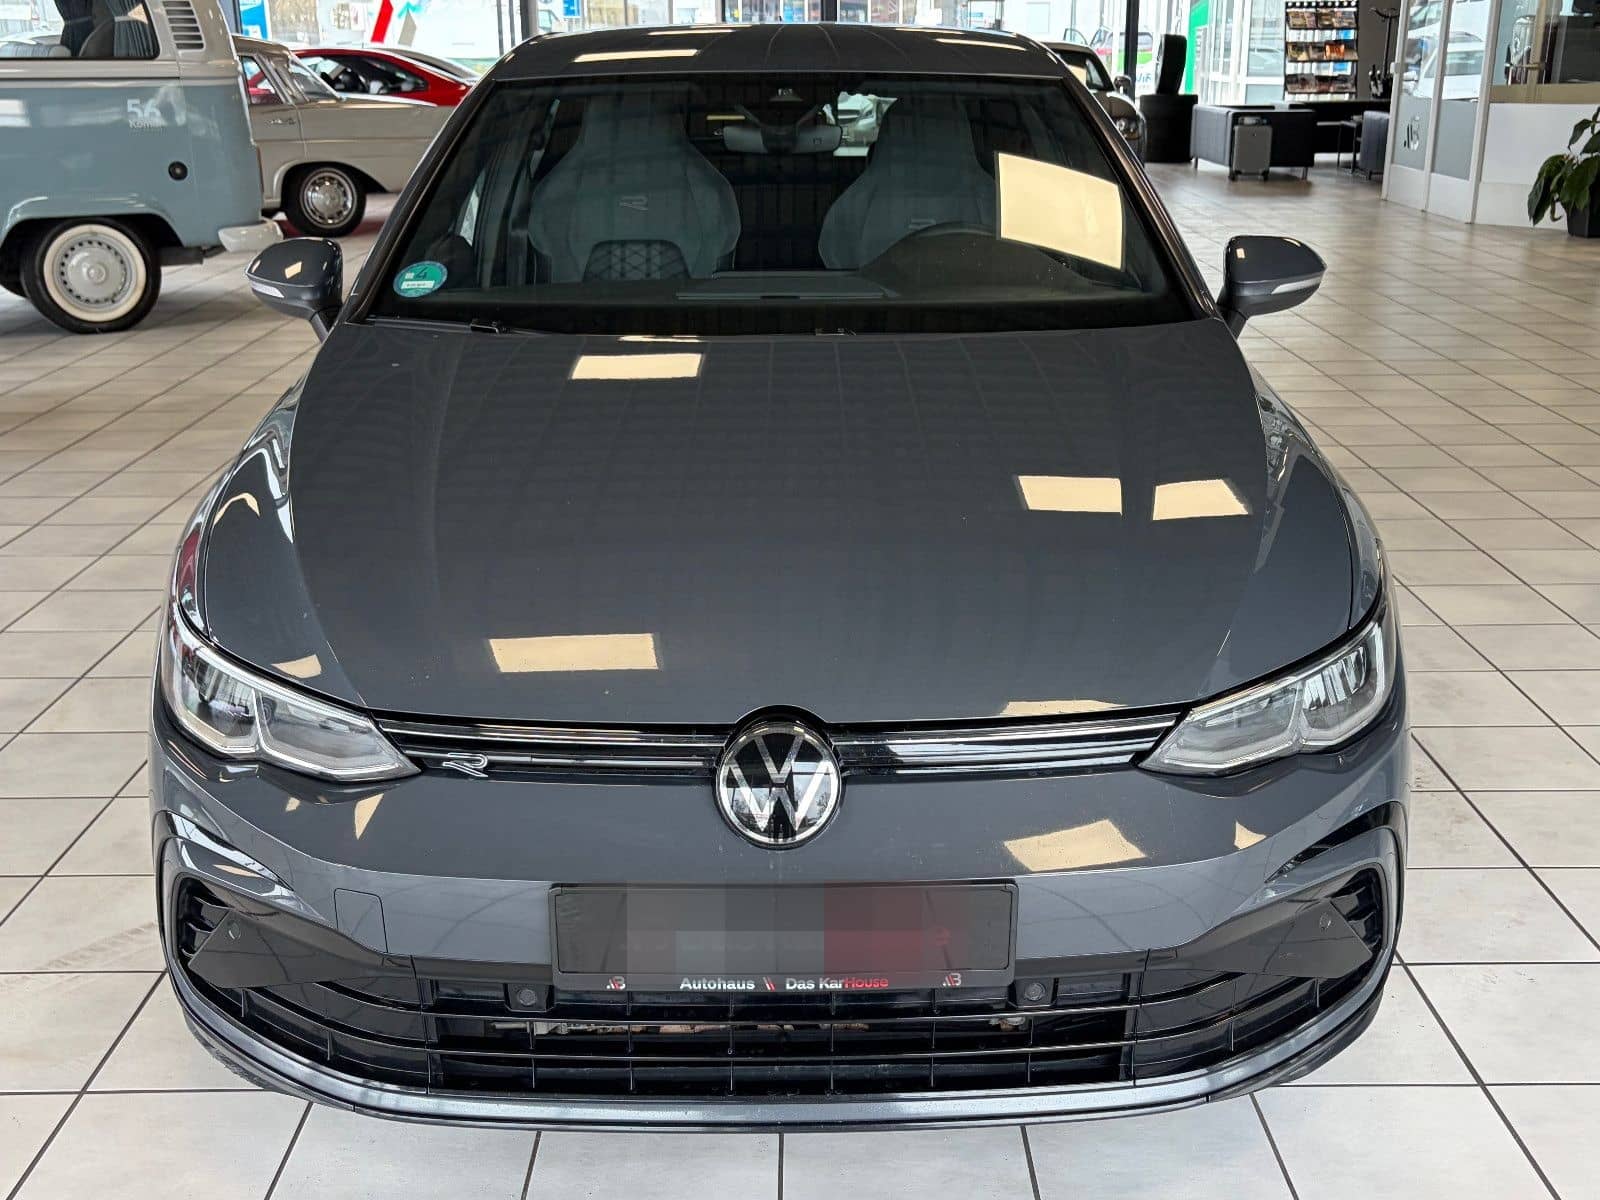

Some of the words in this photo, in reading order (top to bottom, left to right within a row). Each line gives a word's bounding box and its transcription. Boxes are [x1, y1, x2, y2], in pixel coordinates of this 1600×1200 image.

[679, 977, 755, 991] Autohaus
[785, 977, 815, 990] Das
[819, 976, 889, 990] KarHouse
